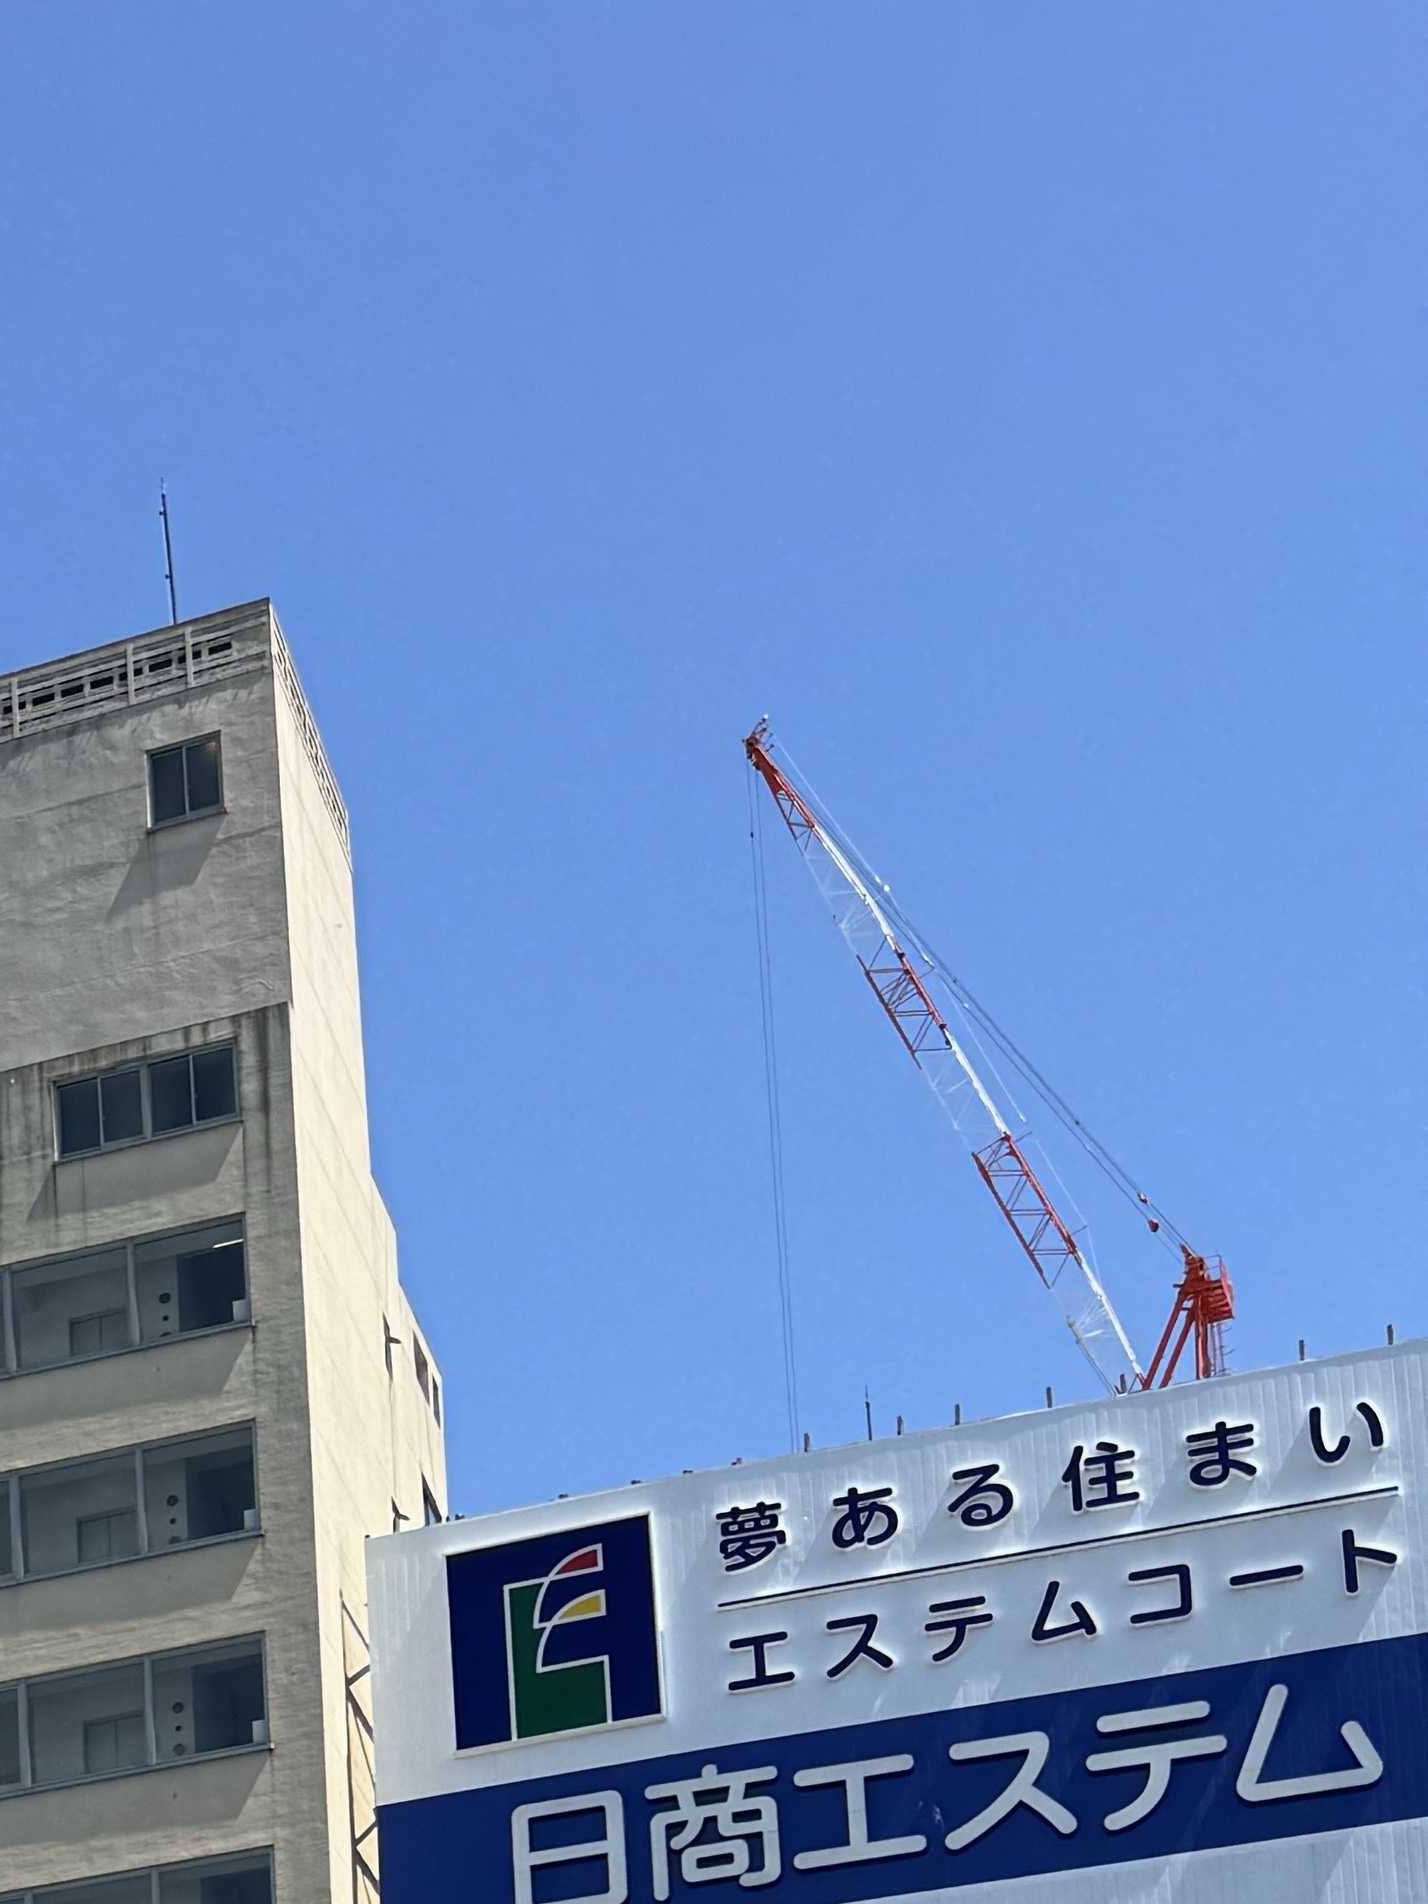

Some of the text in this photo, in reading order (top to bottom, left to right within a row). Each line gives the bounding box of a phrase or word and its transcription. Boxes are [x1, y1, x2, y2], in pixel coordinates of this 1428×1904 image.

[716, 1400, 1384, 1573] 夢ある住まい
[729, 1529, 1398, 1693] エステムコート
